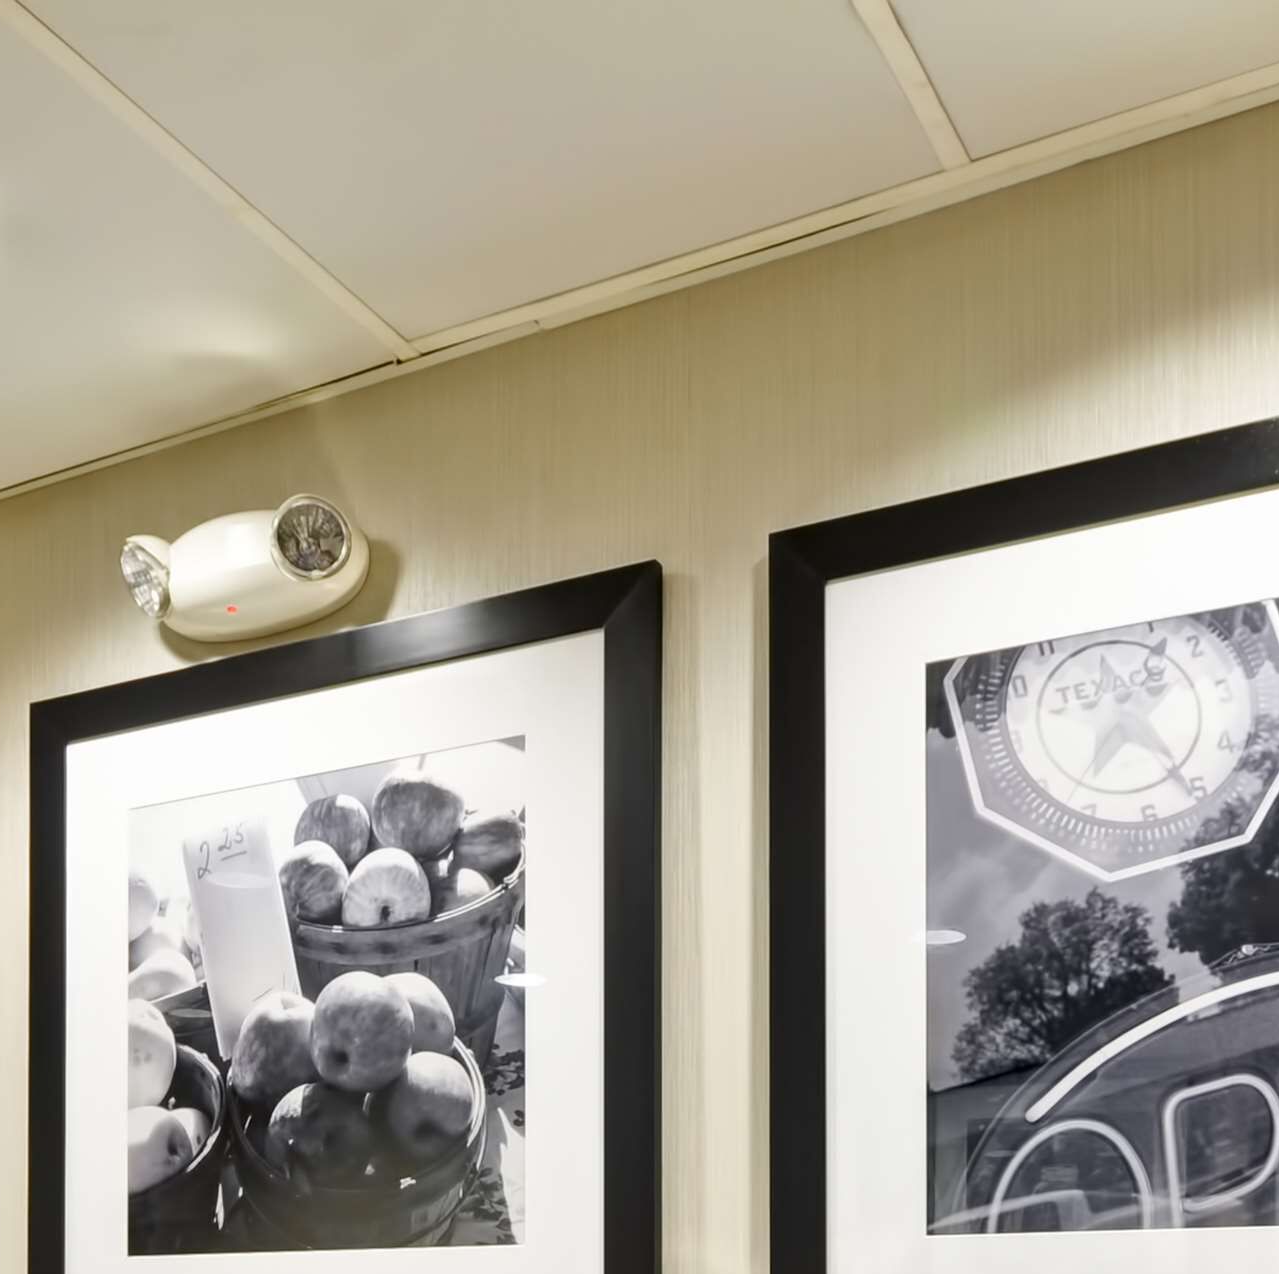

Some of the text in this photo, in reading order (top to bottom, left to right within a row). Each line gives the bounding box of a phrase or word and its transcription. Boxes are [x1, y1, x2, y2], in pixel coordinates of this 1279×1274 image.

[1186, 634, 1204, 658] 2
[1217, 729, 1234, 753] 4
[1189, 776, 1208, 802] 5
[197, 841, 213, 880] 2
